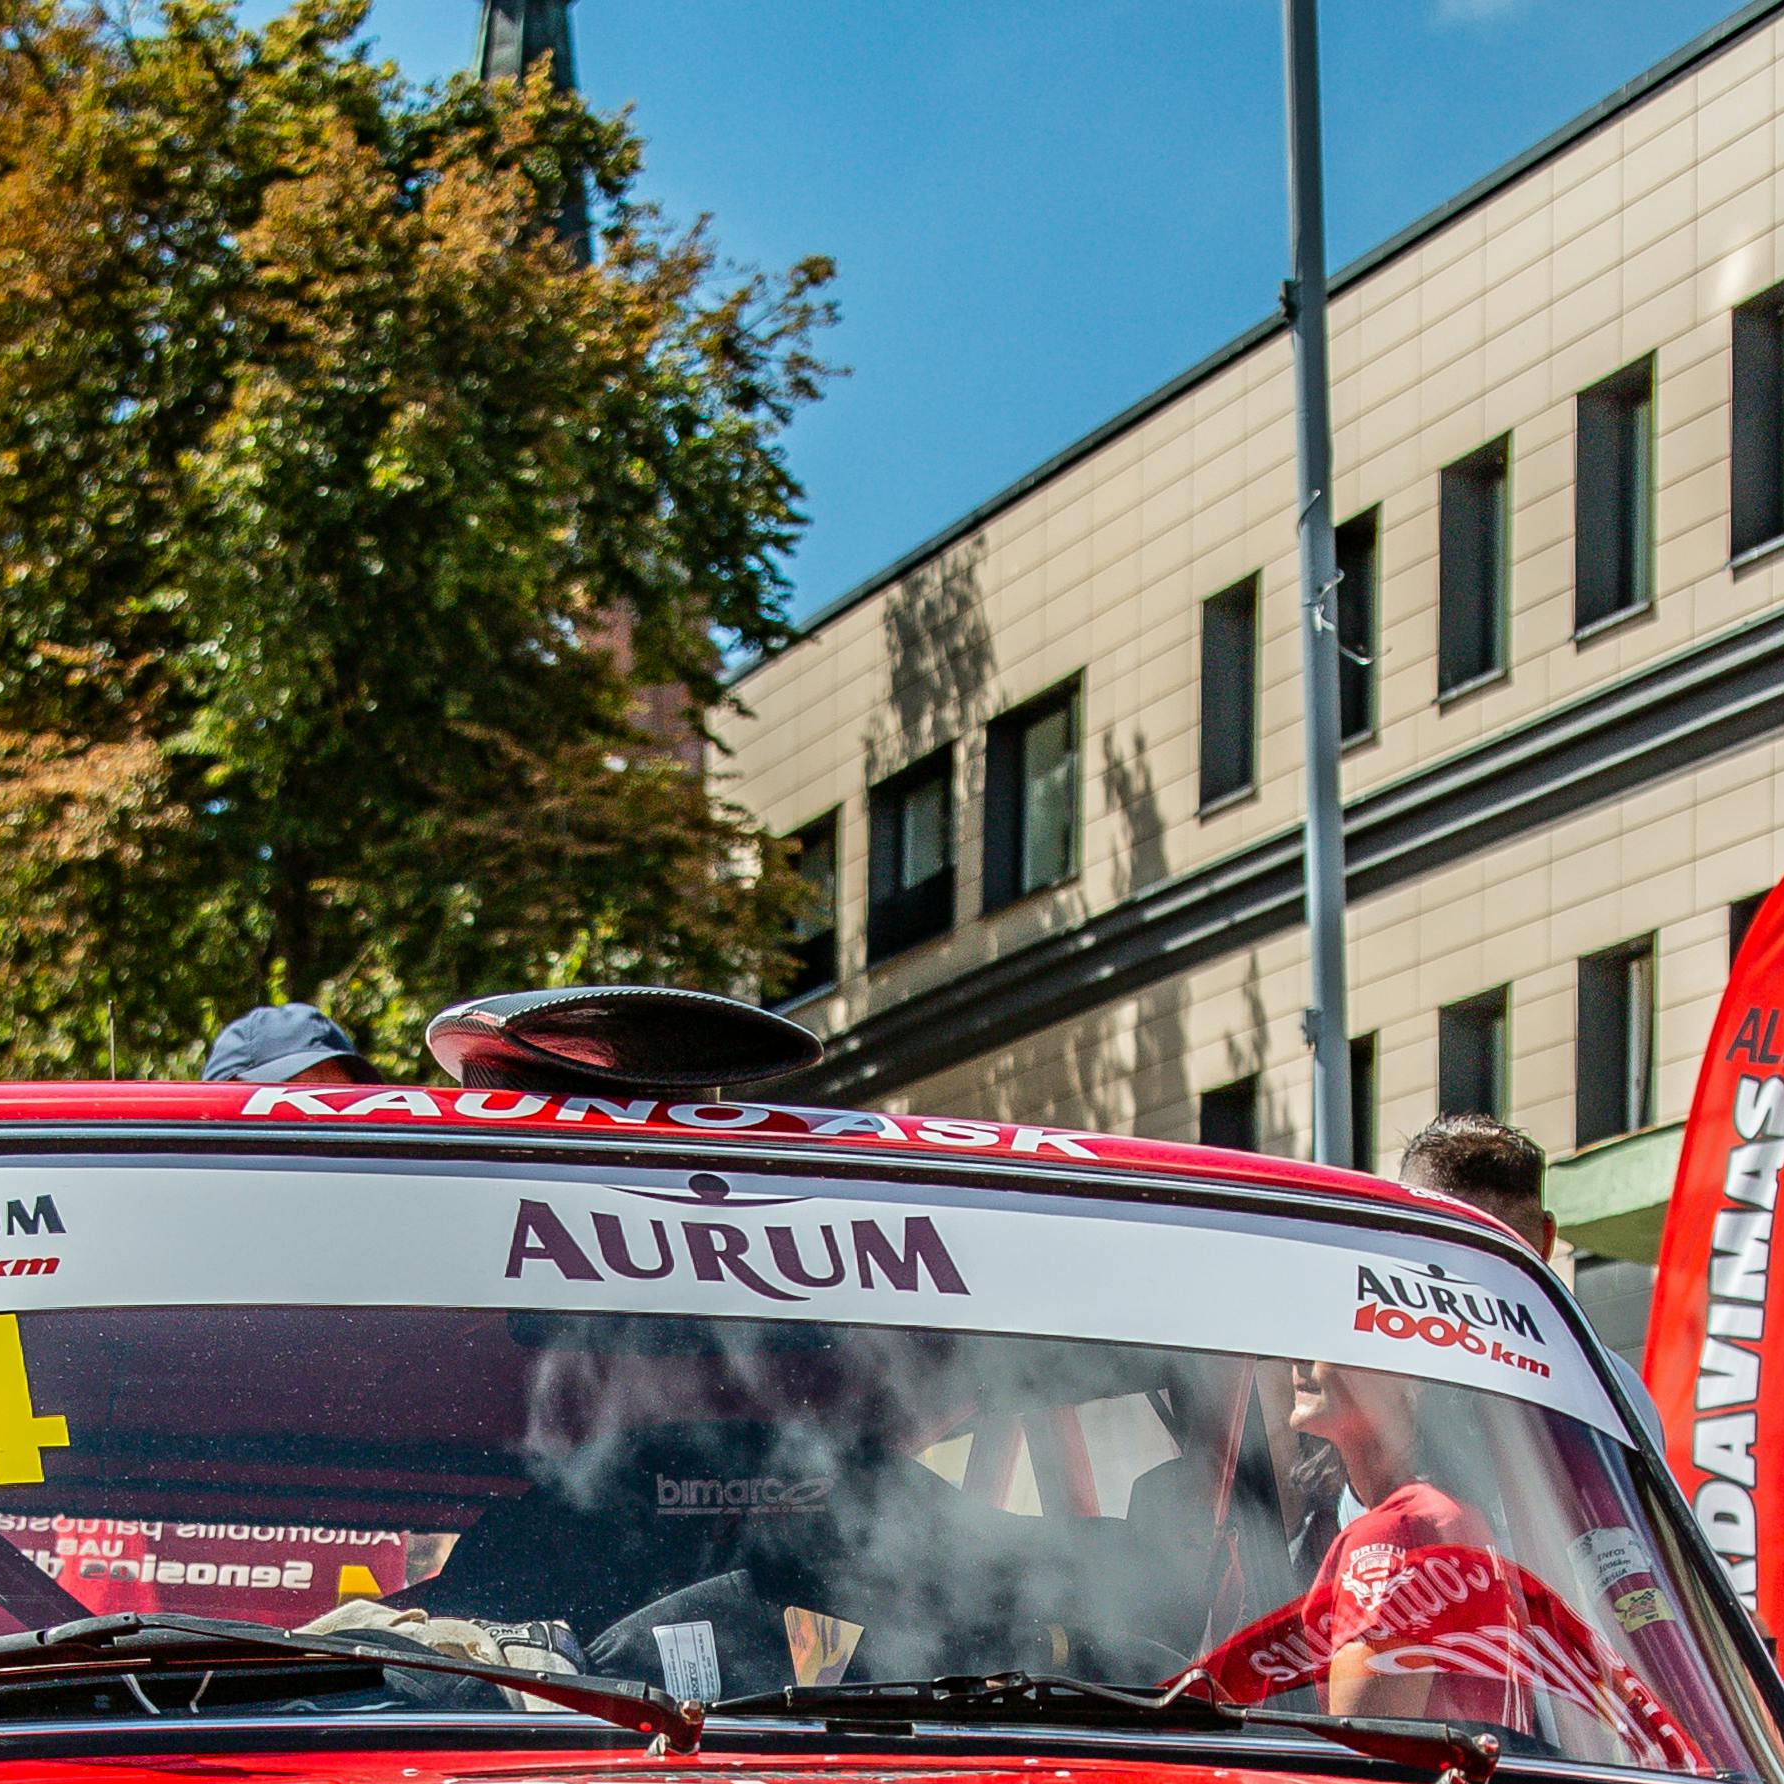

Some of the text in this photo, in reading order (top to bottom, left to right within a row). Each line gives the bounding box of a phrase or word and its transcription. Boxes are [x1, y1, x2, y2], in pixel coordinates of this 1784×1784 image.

[240, 1086, 1106, 1160] KAUNO ASK
[504, 1198, 972, 1302] AURUM
[1356, 1264, 1547, 1346] AURUM
